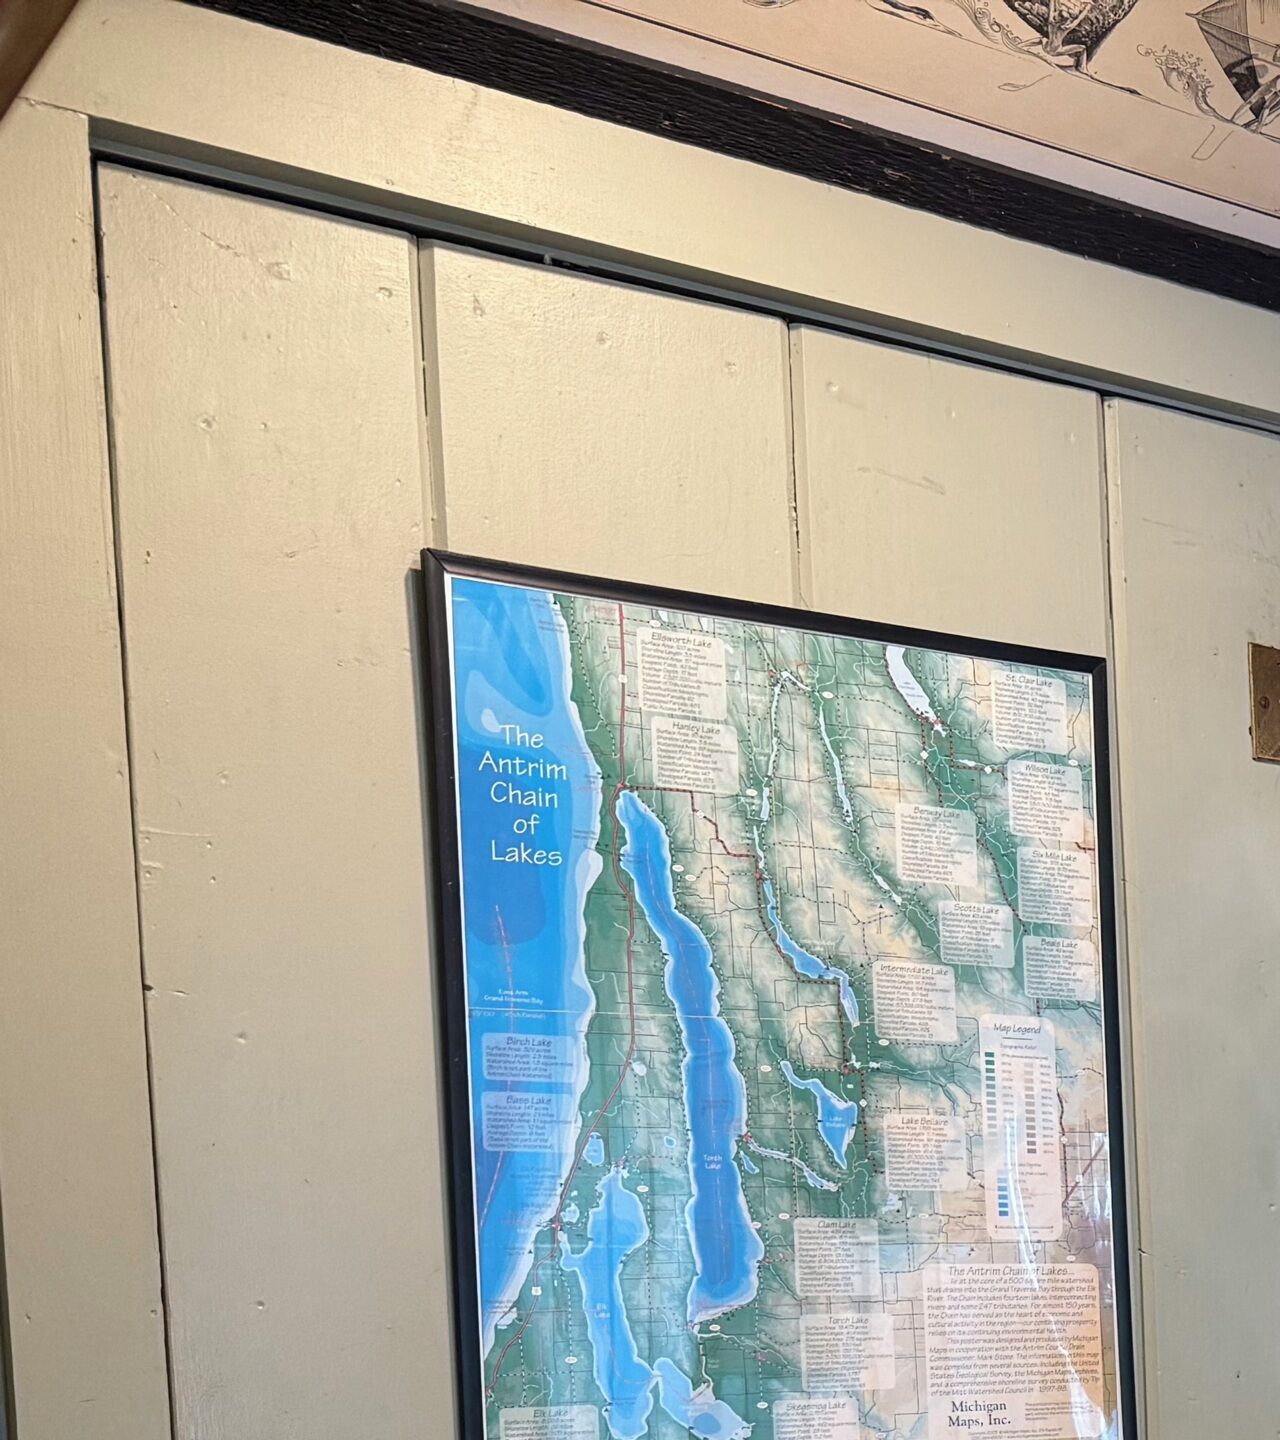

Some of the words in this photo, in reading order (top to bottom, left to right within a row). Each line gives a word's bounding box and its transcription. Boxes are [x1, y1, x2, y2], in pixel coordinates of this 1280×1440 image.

[693, 637, 712, 649] Lake
[1036, 678, 1053, 688] Lake
[702, 724, 721, 736] Lake
[499, 724, 544, 748] The
[478, 751, 567, 781] Antrim
[1049, 766, 1066, 775] Lake
[490, 781, 558, 808] Chain
[943, 808, 961, 819] Lake
[513, 814, 540, 835] of
[491, 840, 563, 866] Lakes
[1061, 853, 1077, 863] Lake
[982, 906, 1000, 915] Lake
[1061, 940, 1078, 949] Lake
[880, 963, 931, 975] Intermediate
[931, 967, 949, 976] Lake
[993, 1024, 1012, 1034] Map
[1013, 1024, 1042, 1036] Legend
[506, 1036, 531, 1047] Birch
[531, 1037, 552, 1048] Lake
[531, 1095, 551, 1106] Lake
[901, 1116, 919, 1125] Lake
[839, 1221, 857, 1229] Lake
[949, 1266, 965, 1276] The
[966, 1266, 1001, 1276] Antrim
[1002, 1265, 1028, 1276] Chain
[829, 1316, 850, 1325] Torch
[851, 1316, 869, 1325] Lake
[829, 1401, 847, 1409] Lake
[951, 1400, 1007, 1414] Michigan
[548, 1409, 569, 1418] Lake
[948, 1414, 984, 1429] Maps,
[988, 1414, 1011, 1426] Inc.
